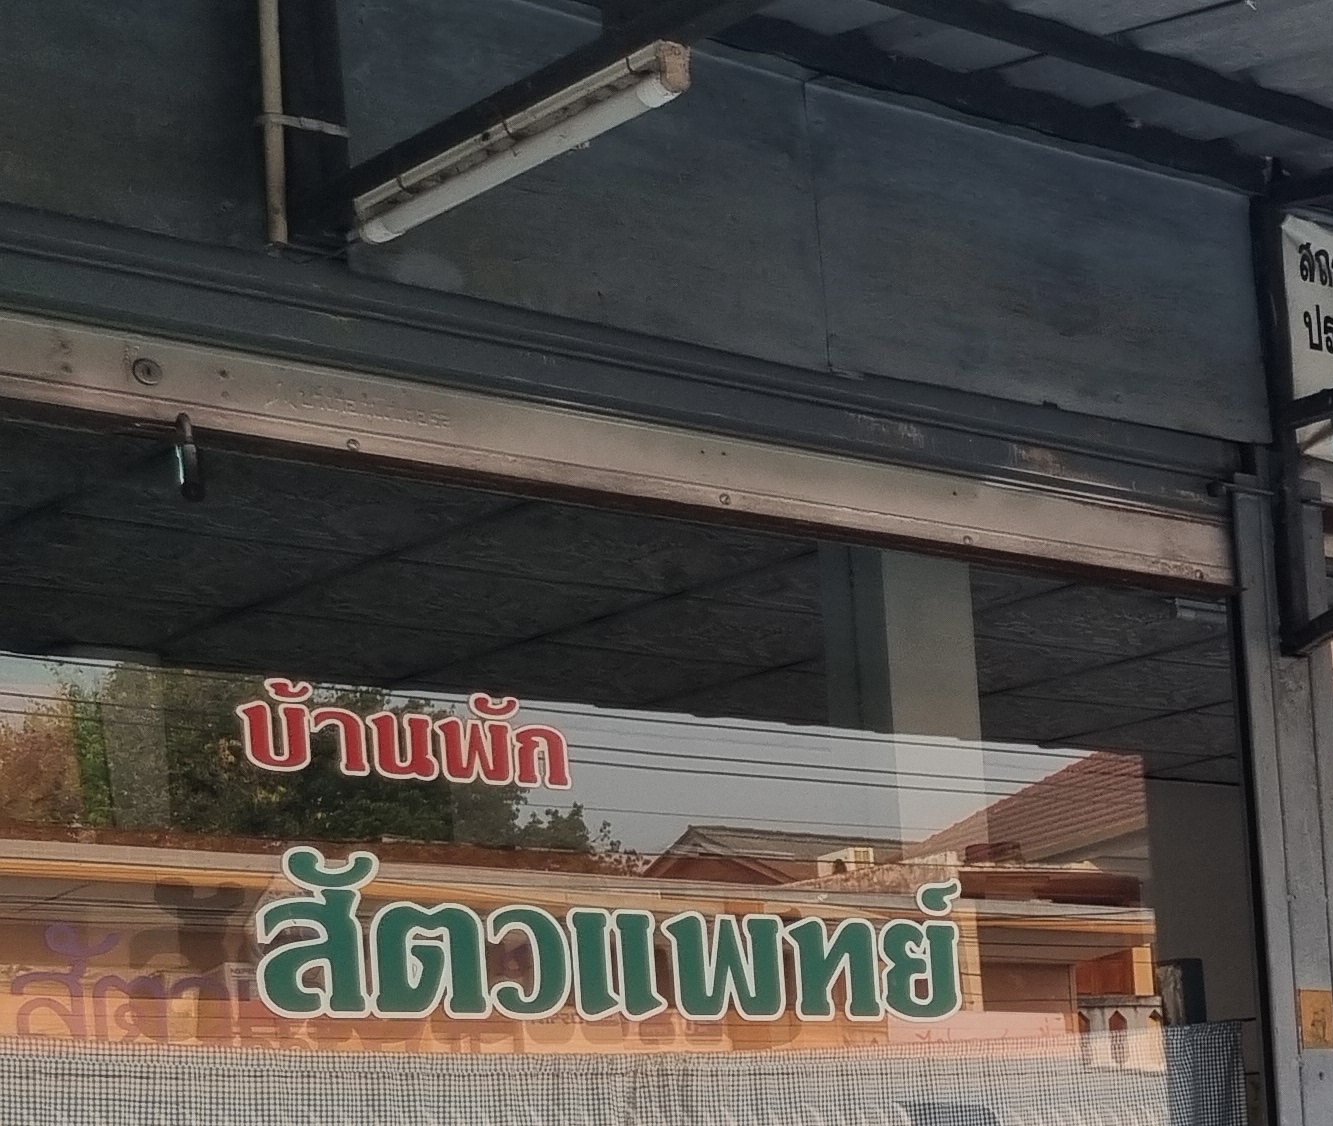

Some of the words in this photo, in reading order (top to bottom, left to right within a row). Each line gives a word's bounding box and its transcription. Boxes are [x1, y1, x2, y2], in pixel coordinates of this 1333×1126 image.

[237, 677, 572, 791] บ้านพัก
[256, 845, 963, 1022] สัตวแพทย์
